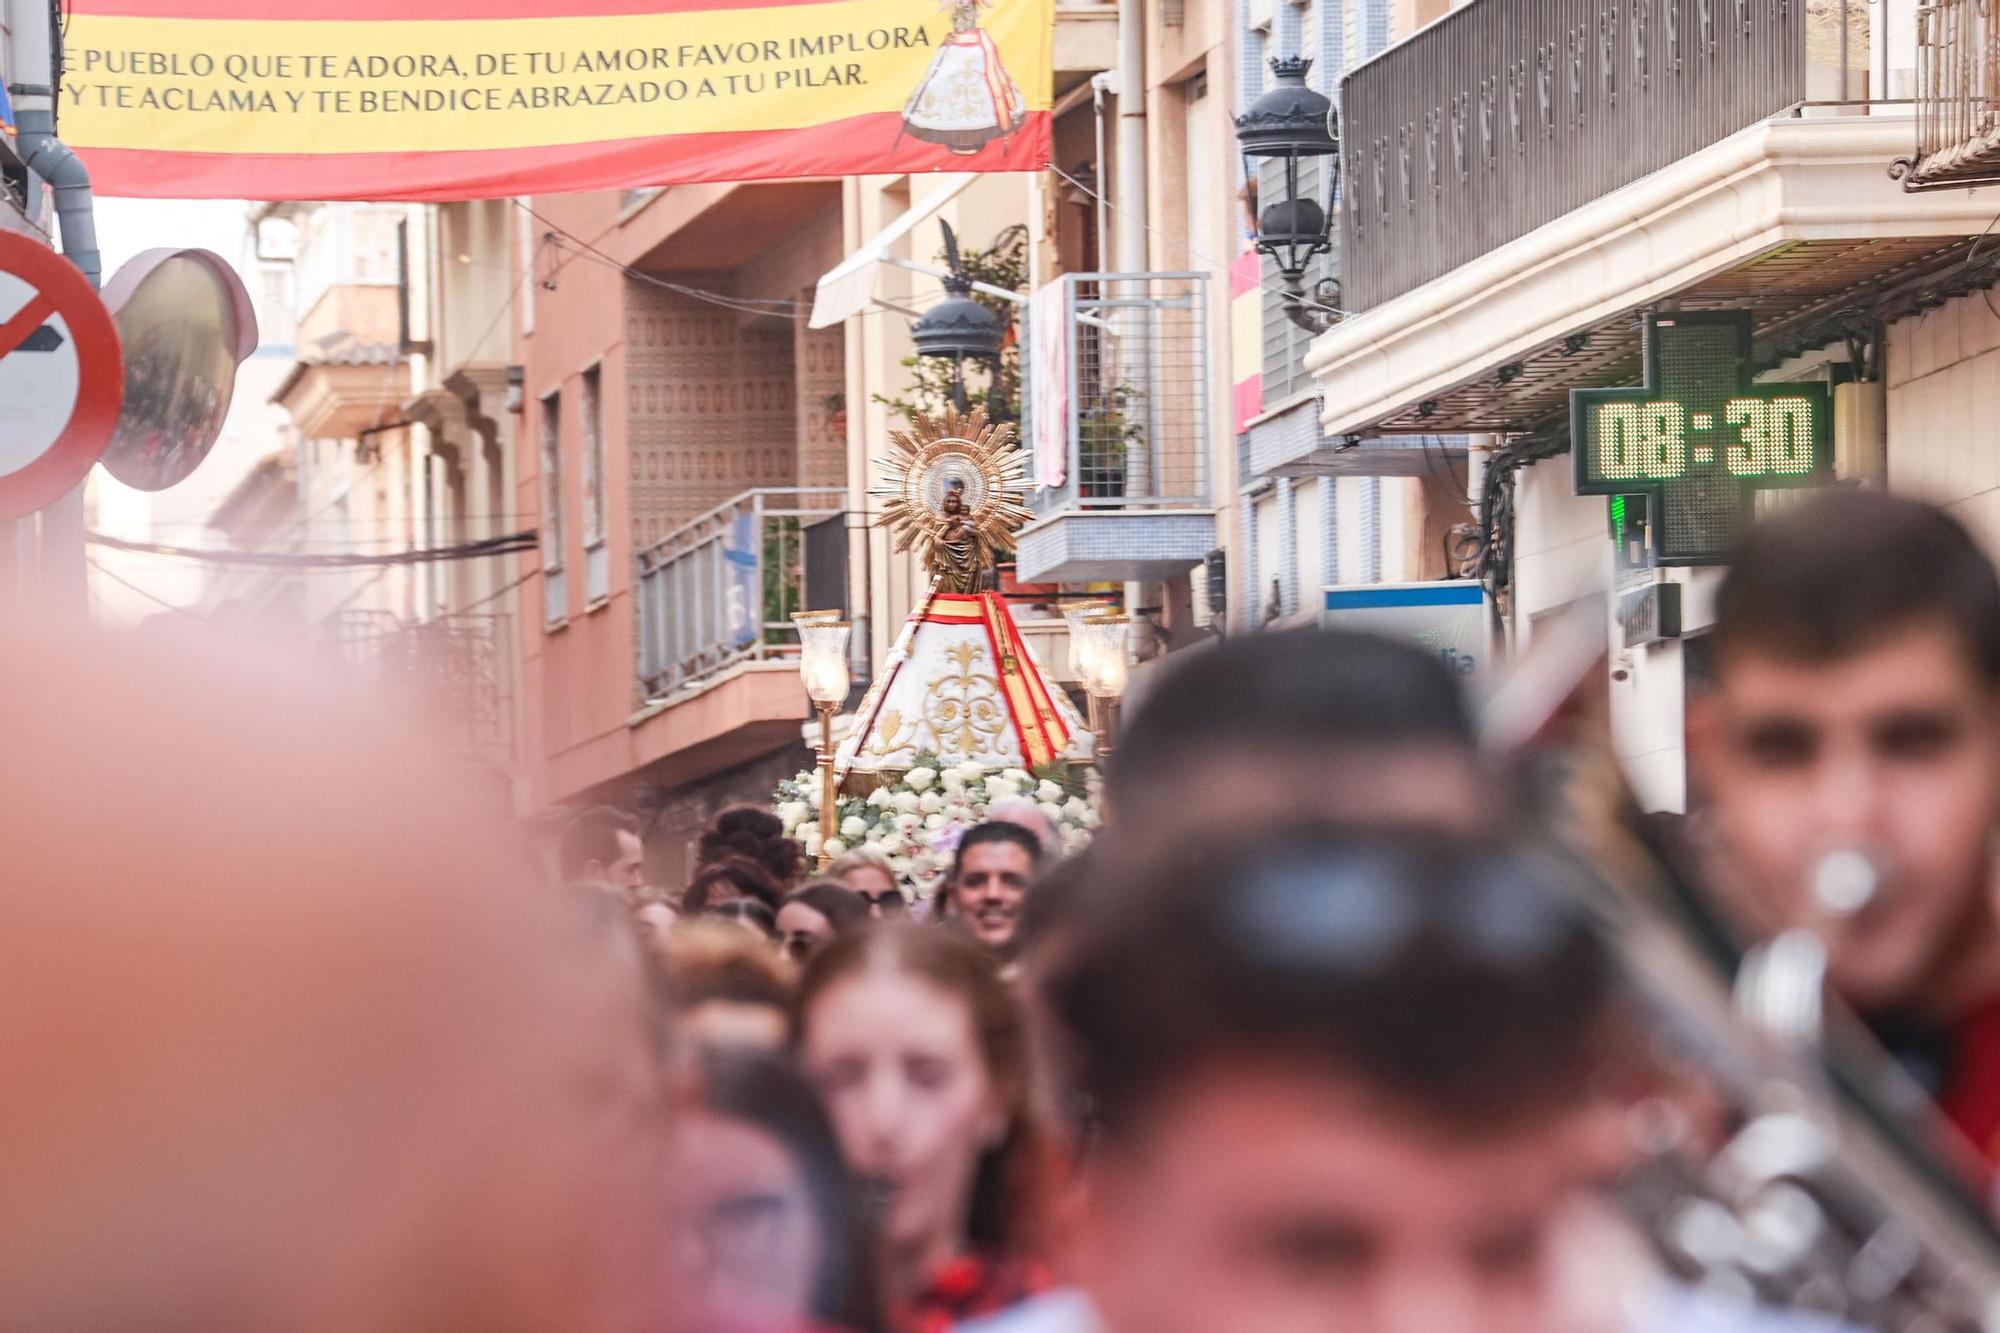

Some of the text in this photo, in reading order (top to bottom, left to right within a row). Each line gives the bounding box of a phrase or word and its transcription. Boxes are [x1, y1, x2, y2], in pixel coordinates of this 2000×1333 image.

[84, 49, 214, 76] PUEBLO
[223, 54, 293, 84] QUE
[298, 55, 338, 79] TE
[343, 53, 468, 80] ADORA,
[476, 52, 518, 76] DE
[522, 51, 565, 75] TU
[572, 47, 670, 73] AMOR
[677, 40, 782, 68] FAVOR
[789, 25, 930, 59] IMPLORA
[65, 63, 868, 113] Y TE ACLAMA Y TE BENDICE ABRAZADO A TU PILAR.
[1598, 397, 1814, 479] 08:30
